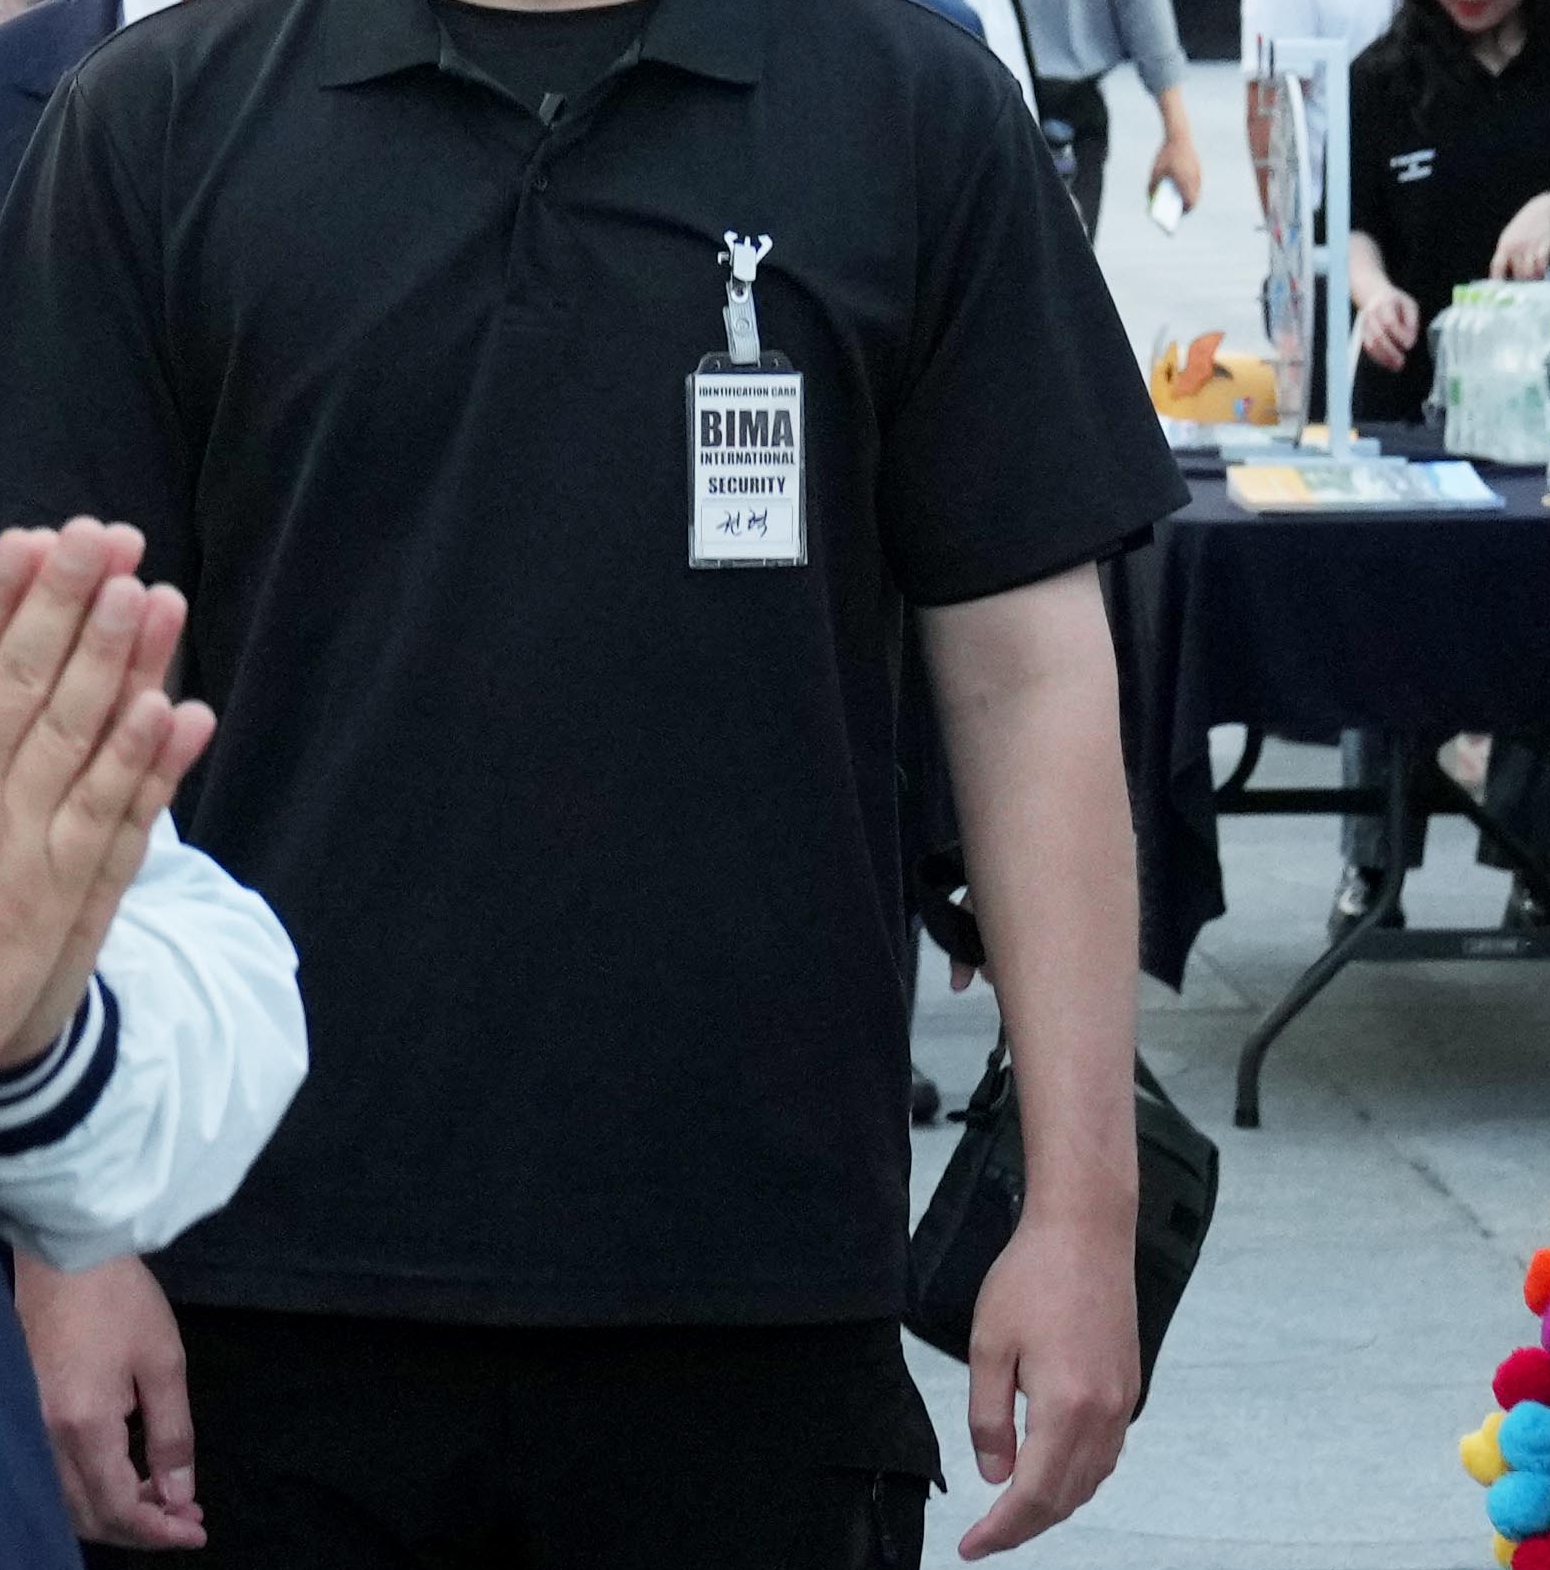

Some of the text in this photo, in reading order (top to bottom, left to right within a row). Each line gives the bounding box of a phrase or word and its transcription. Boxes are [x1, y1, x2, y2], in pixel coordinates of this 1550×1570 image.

[698, 385, 797, 397] IDENTIFICATION CARD
[700, 408, 795, 447] BIMA
[700, 450, 796, 466] INTERNATIONAL
[708, 475, 786, 495] SECURITY
